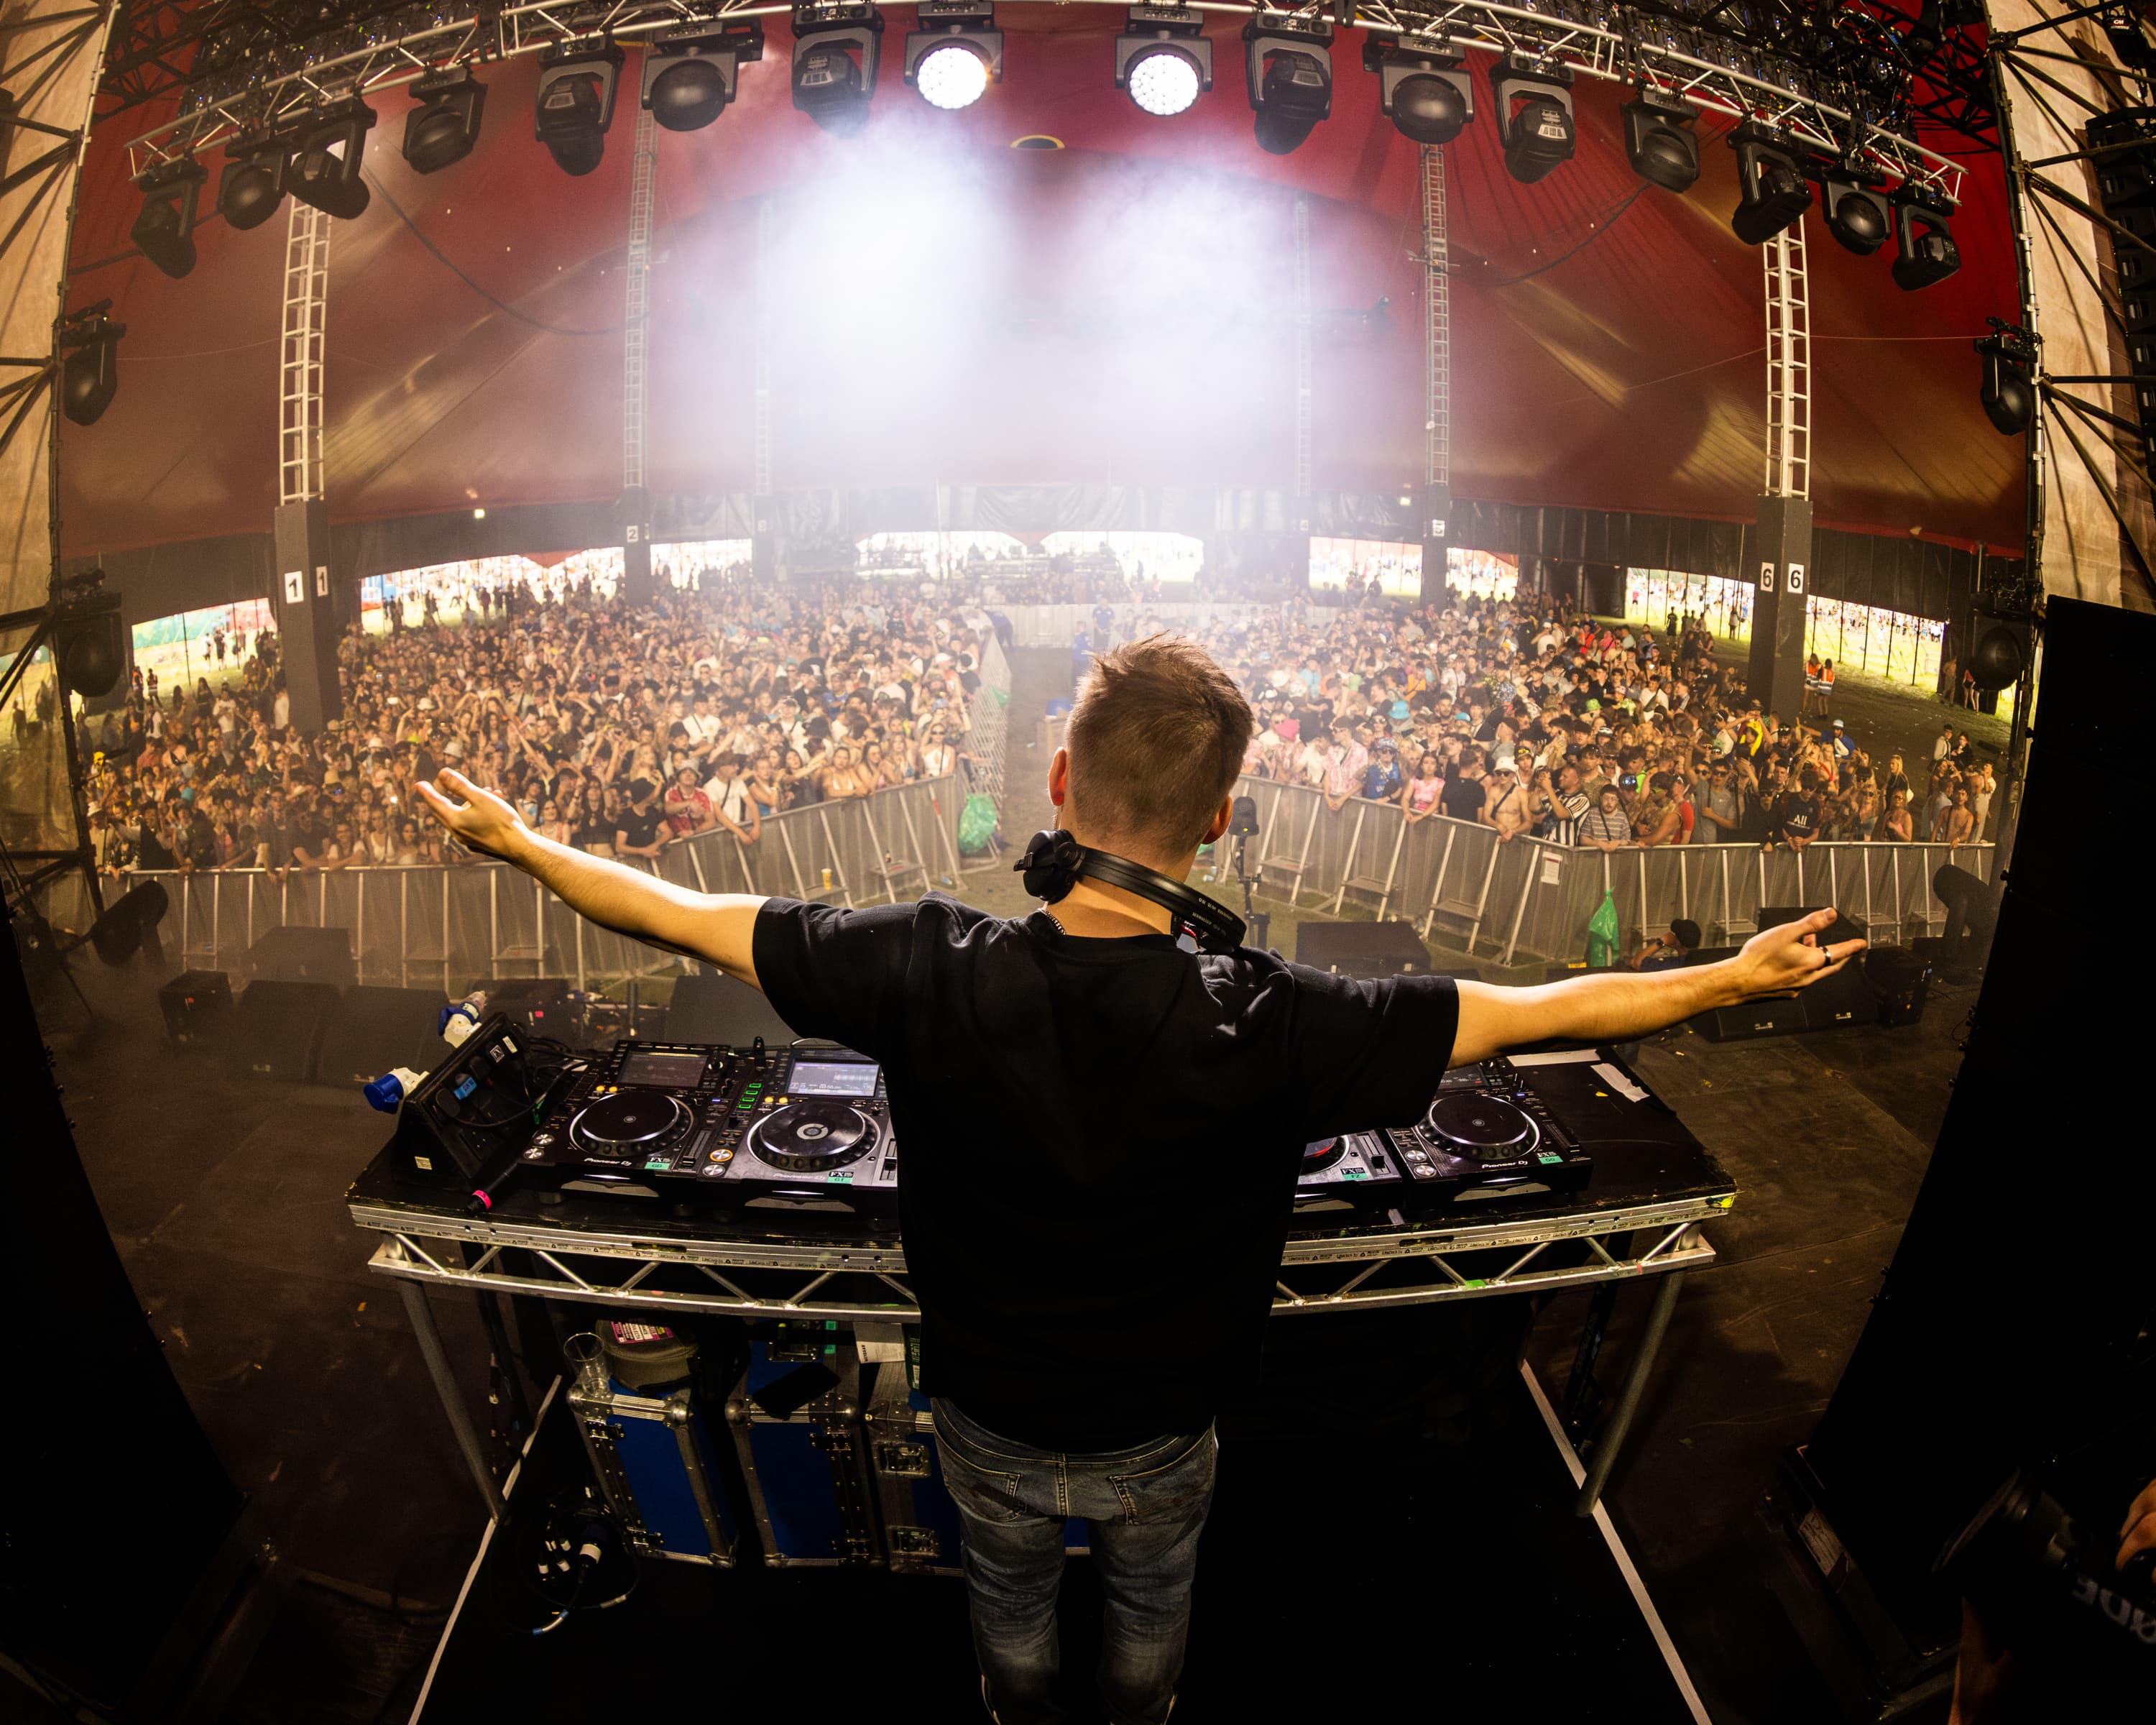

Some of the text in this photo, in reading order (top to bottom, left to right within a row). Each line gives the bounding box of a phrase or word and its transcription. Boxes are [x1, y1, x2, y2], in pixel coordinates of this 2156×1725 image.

[629, 528, 636, 539] 2
[1435, 523, 1443, 534] 5
[318, 572, 325, 592] 1
[1763, 568, 1772, 588] 6
[1789, 569, 1801, 589] 6
[289, 577, 299, 597] 1
[584, 1156, 620, 1165] Pioneer
[1481, 1161, 1516, 1169] Pioneer
